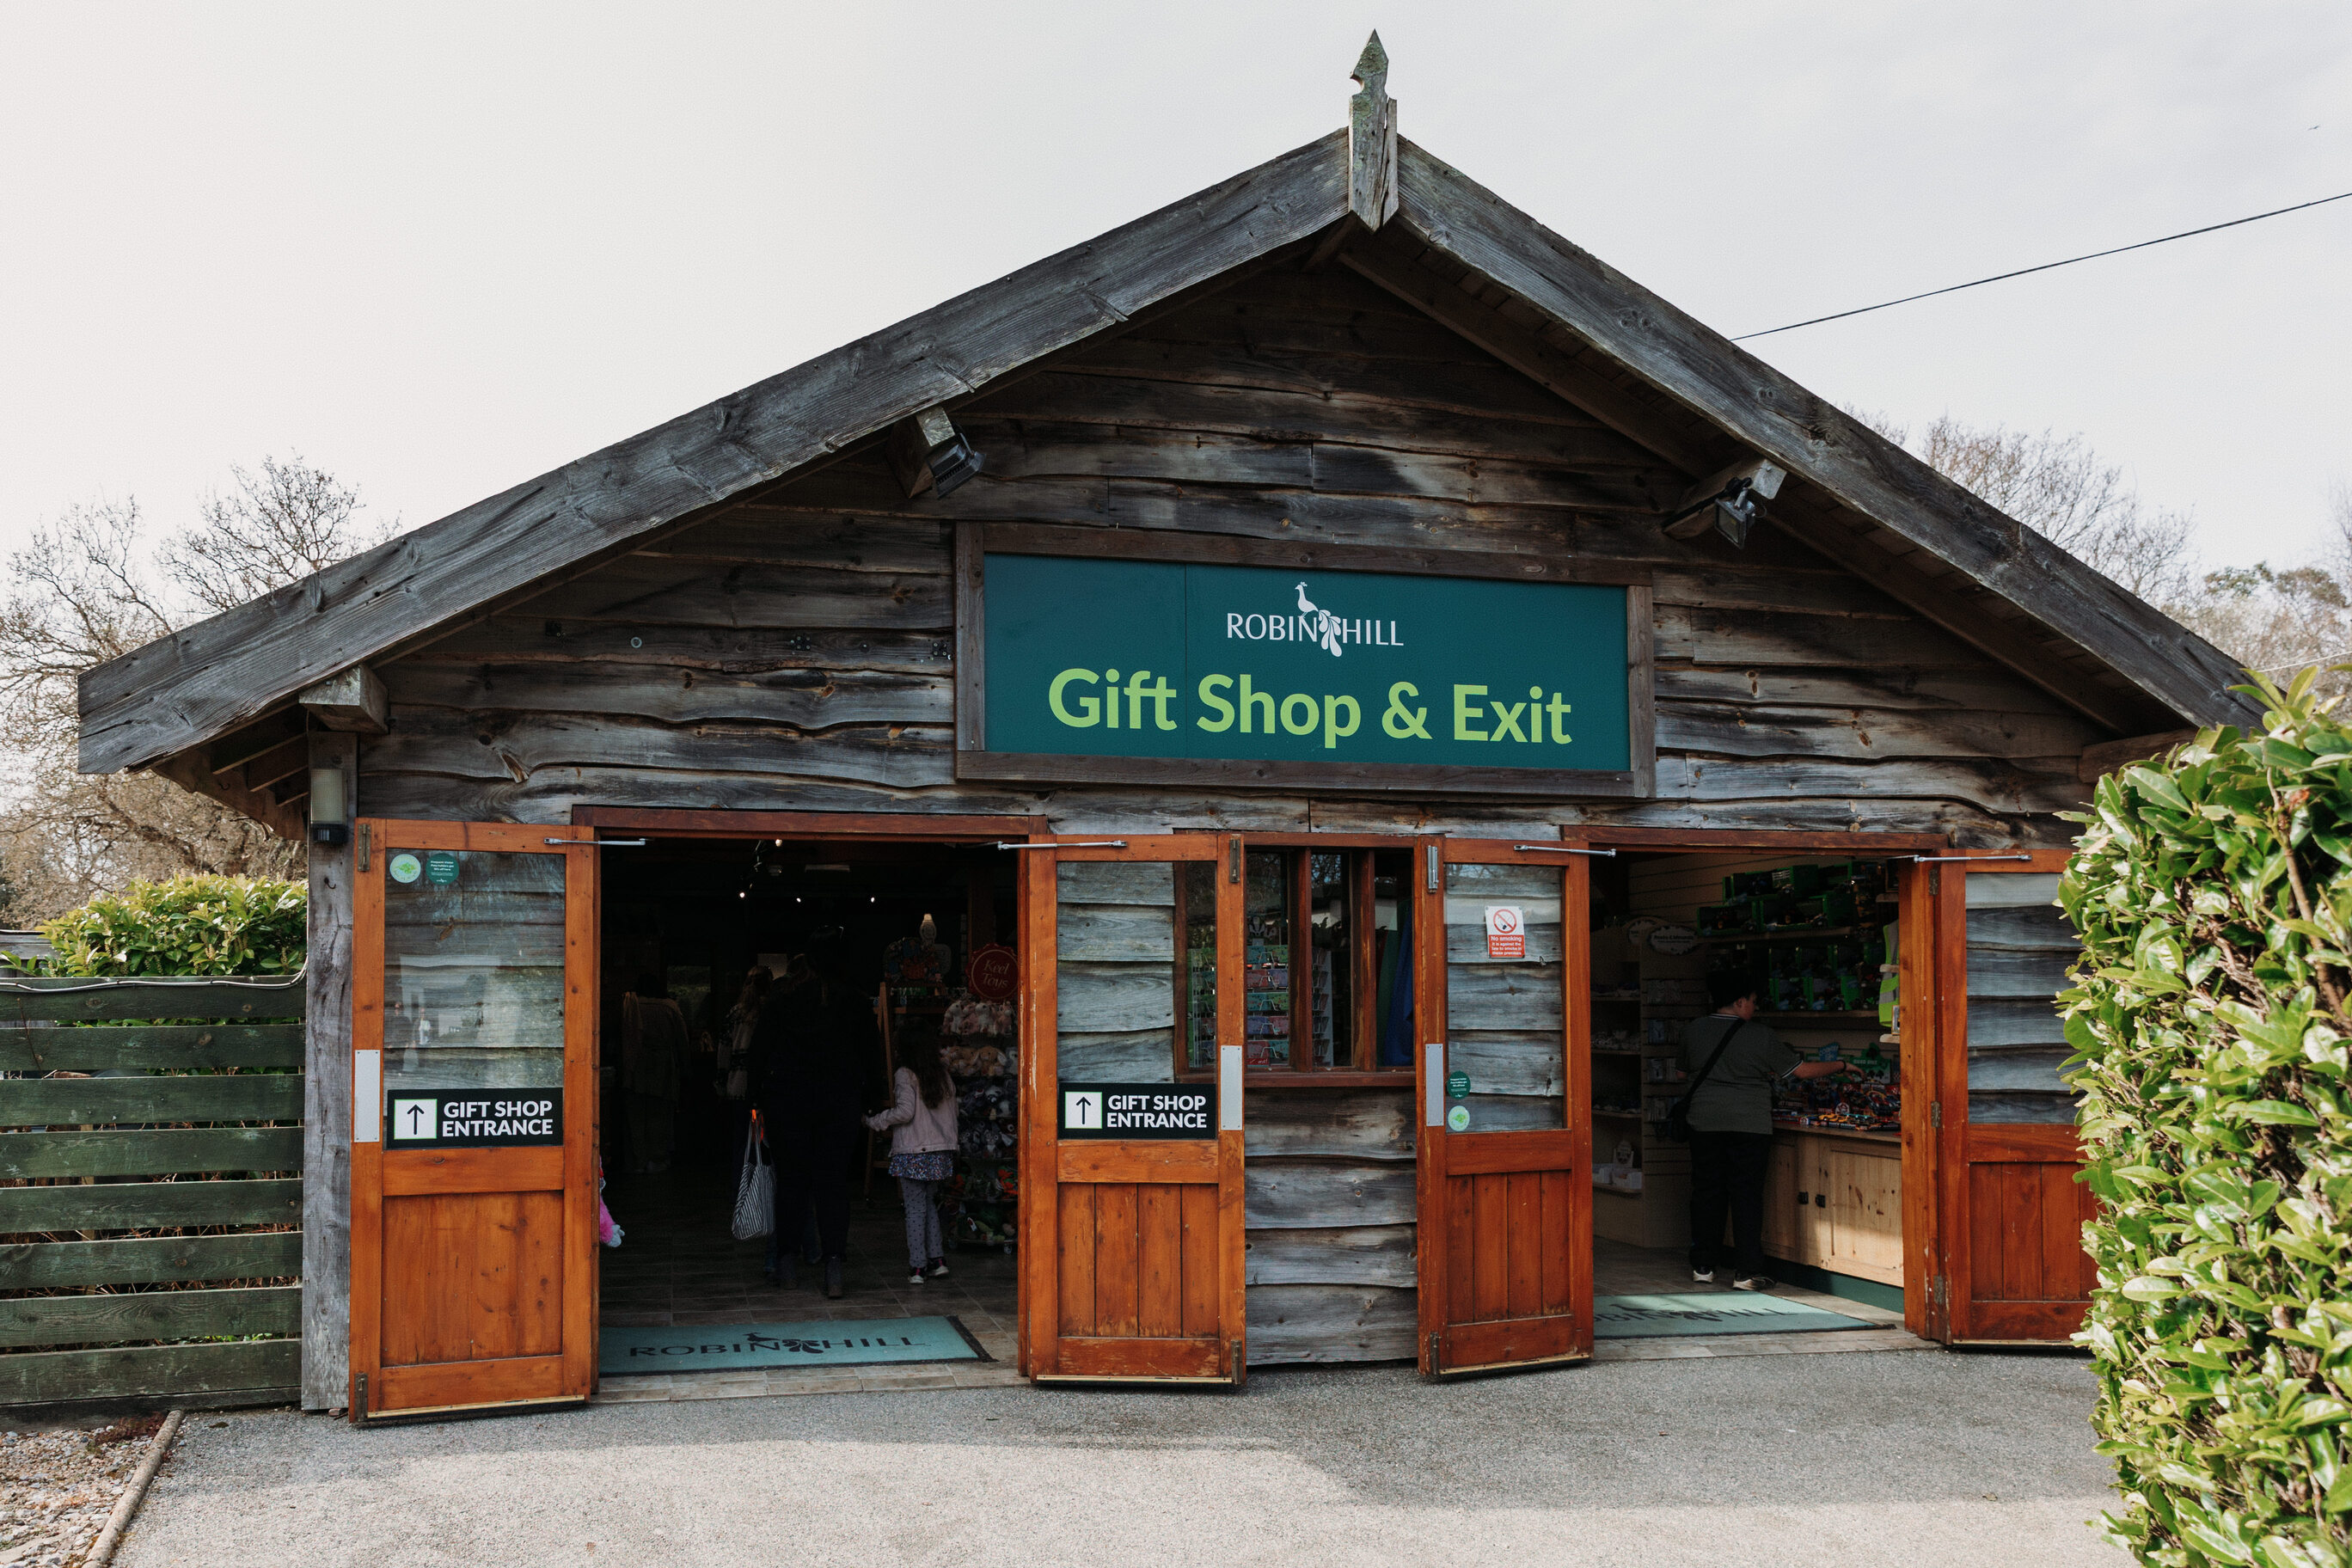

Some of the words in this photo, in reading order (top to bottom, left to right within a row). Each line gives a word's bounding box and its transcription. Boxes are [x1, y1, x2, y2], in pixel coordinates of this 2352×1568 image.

[1227, 613, 1318, 642] ROBIN
[1342, 618, 1404, 646] HILL
[1048, 668, 1178, 731] Gift
[1196, 673, 1362, 749] Shop
[1381, 680, 1433, 740] &
[1453, 683, 1573, 745] Exit
[983, 959, 1009, 974] Keel
[983, 972, 1009, 989] Toys
[444, 1101, 491, 1118] GIFT
[494, 1100, 553, 1117] SHOP
[1107, 1094, 1150, 1111] GIFT
[1153, 1095, 1206, 1111] SHOP
[442, 1119, 554, 1137] ENTRANCE
[1106, 1112, 1207, 1128] ENTRANCE
[629, 1342, 781, 1357] ROBIN
[822, 1337, 928, 1349] HILL
